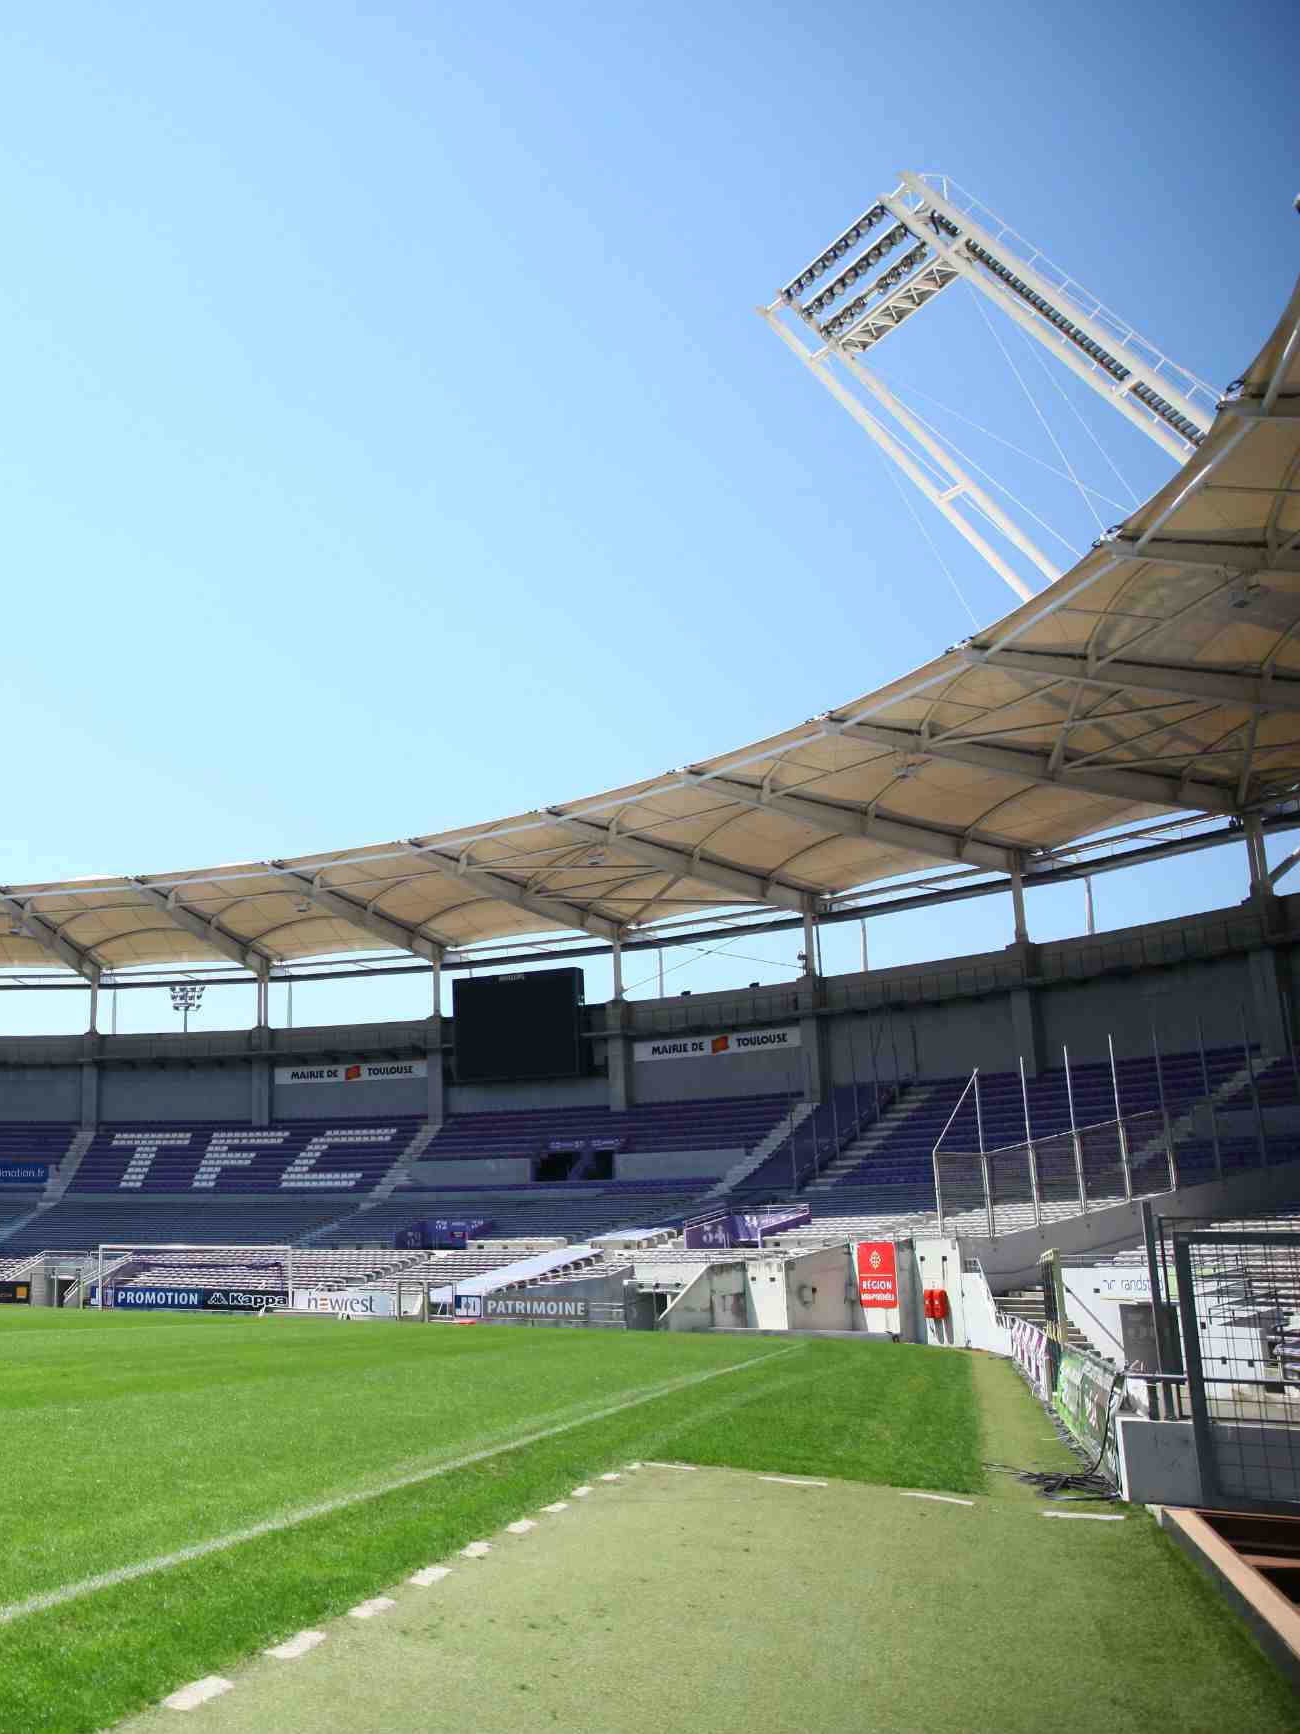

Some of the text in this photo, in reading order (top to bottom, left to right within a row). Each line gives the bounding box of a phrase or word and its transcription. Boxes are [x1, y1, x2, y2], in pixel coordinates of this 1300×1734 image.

[651, 1032, 788, 1055] MAIRIE DE TOULOUSE
[291, 1065, 413, 1080] MAIRIE DE TOULOUSE
[111, 1128, 397, 1188] TFC
[118, 1290, 198, 1305] PROMOTION
[229, 1293, 288, 1307] Kappa
[307, 1291, 376, 1314] newrest
[487, 1299, 587, 1316] PATRIMOINE
